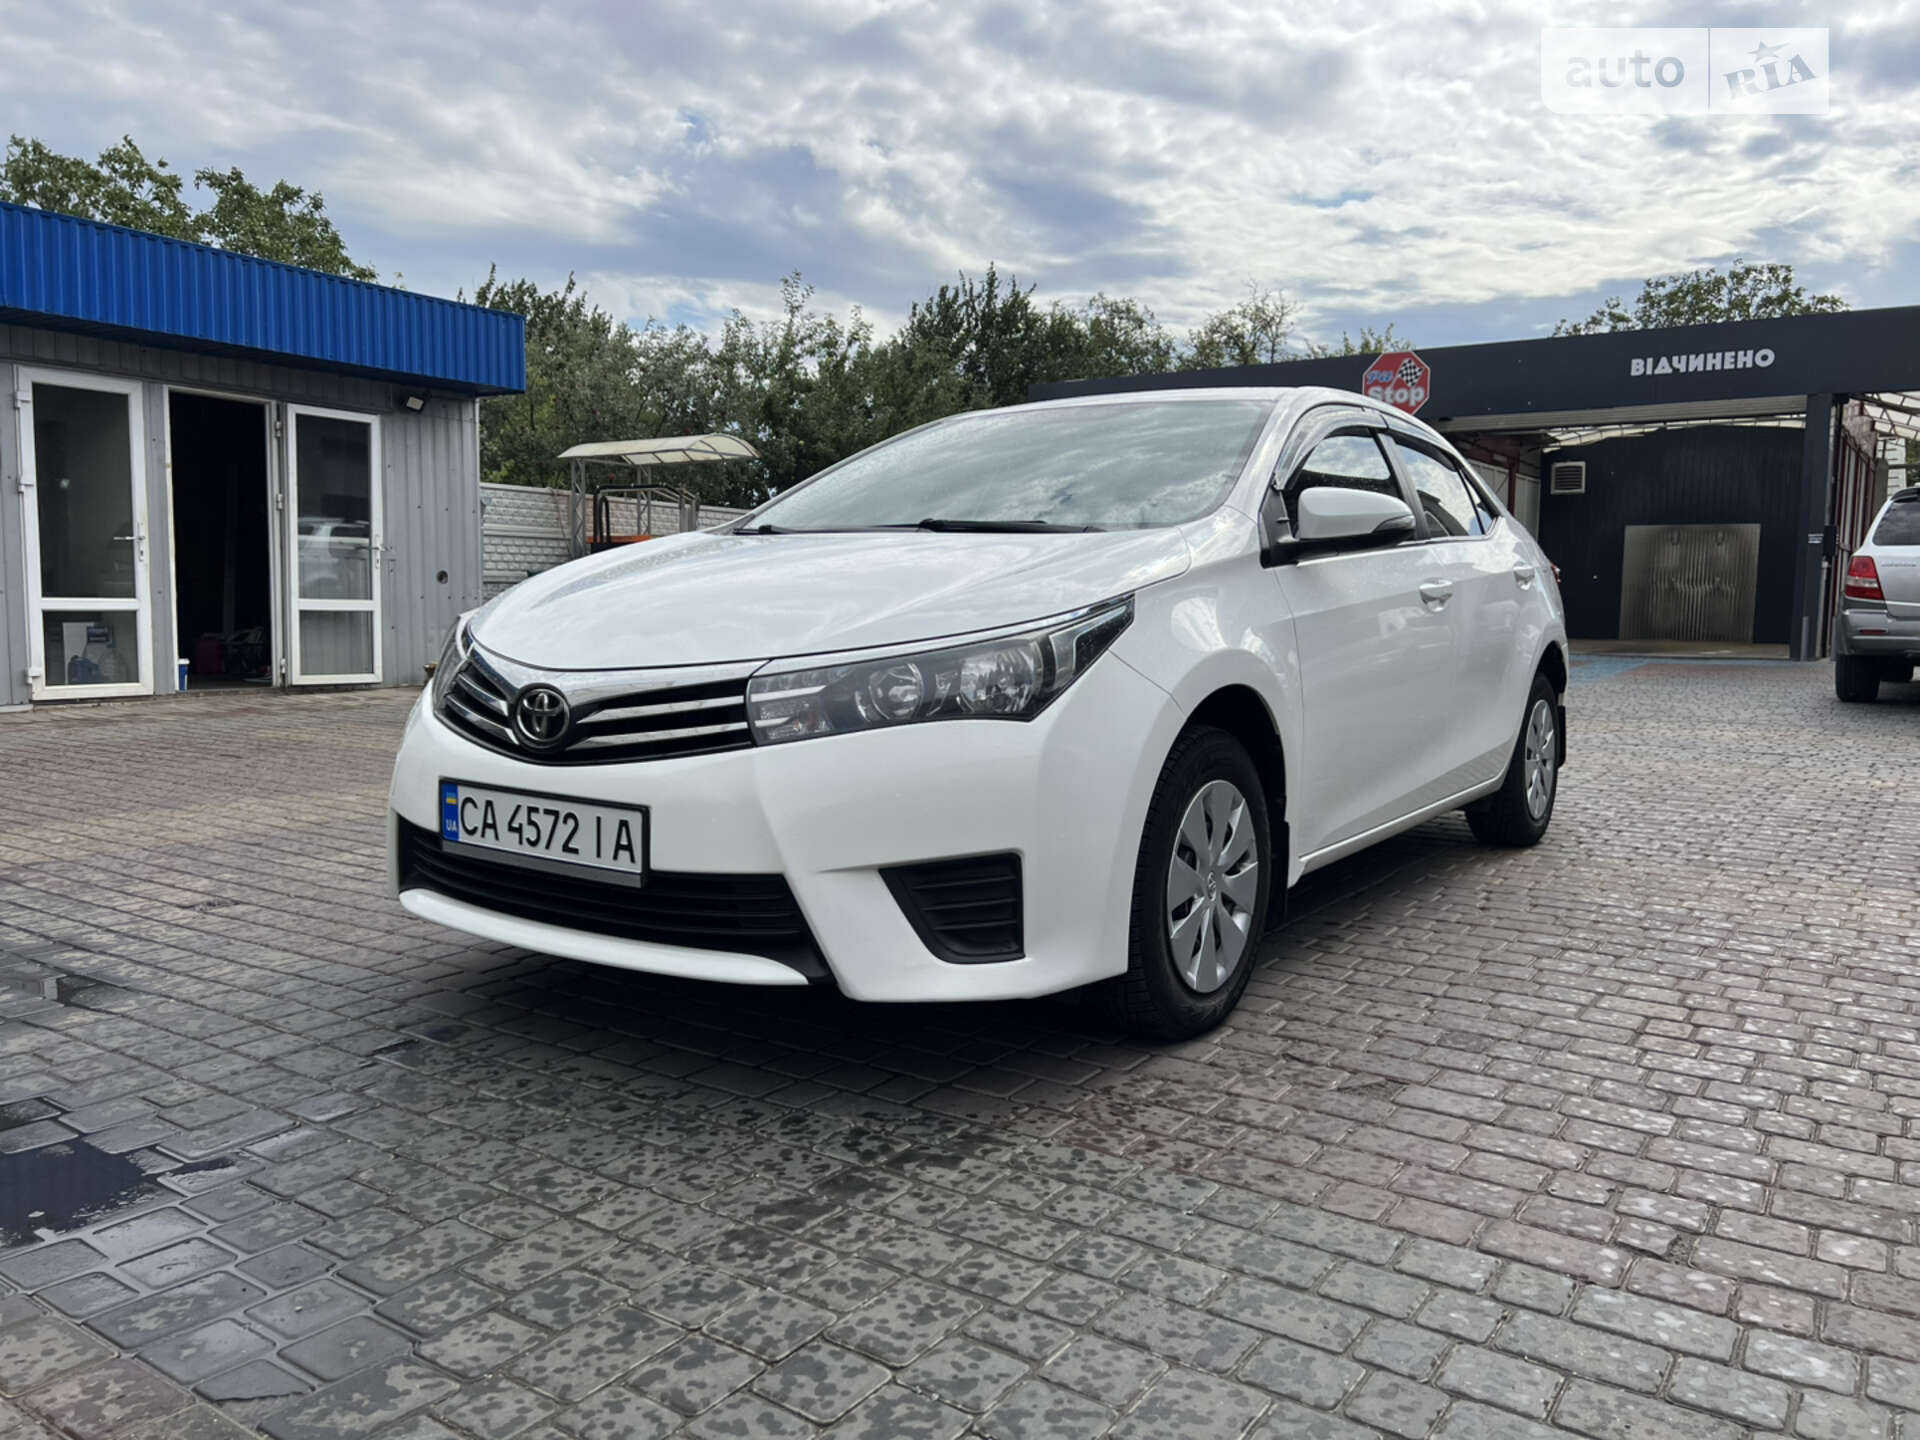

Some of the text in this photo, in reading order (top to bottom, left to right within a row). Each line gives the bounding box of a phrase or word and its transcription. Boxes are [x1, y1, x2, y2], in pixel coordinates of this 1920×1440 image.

[1630, 348, 1776, 377] ВІДЧИНЕНО
[445, 818, 458, 833] UA
[460, 796, 636, 864] CA 4572 IA
